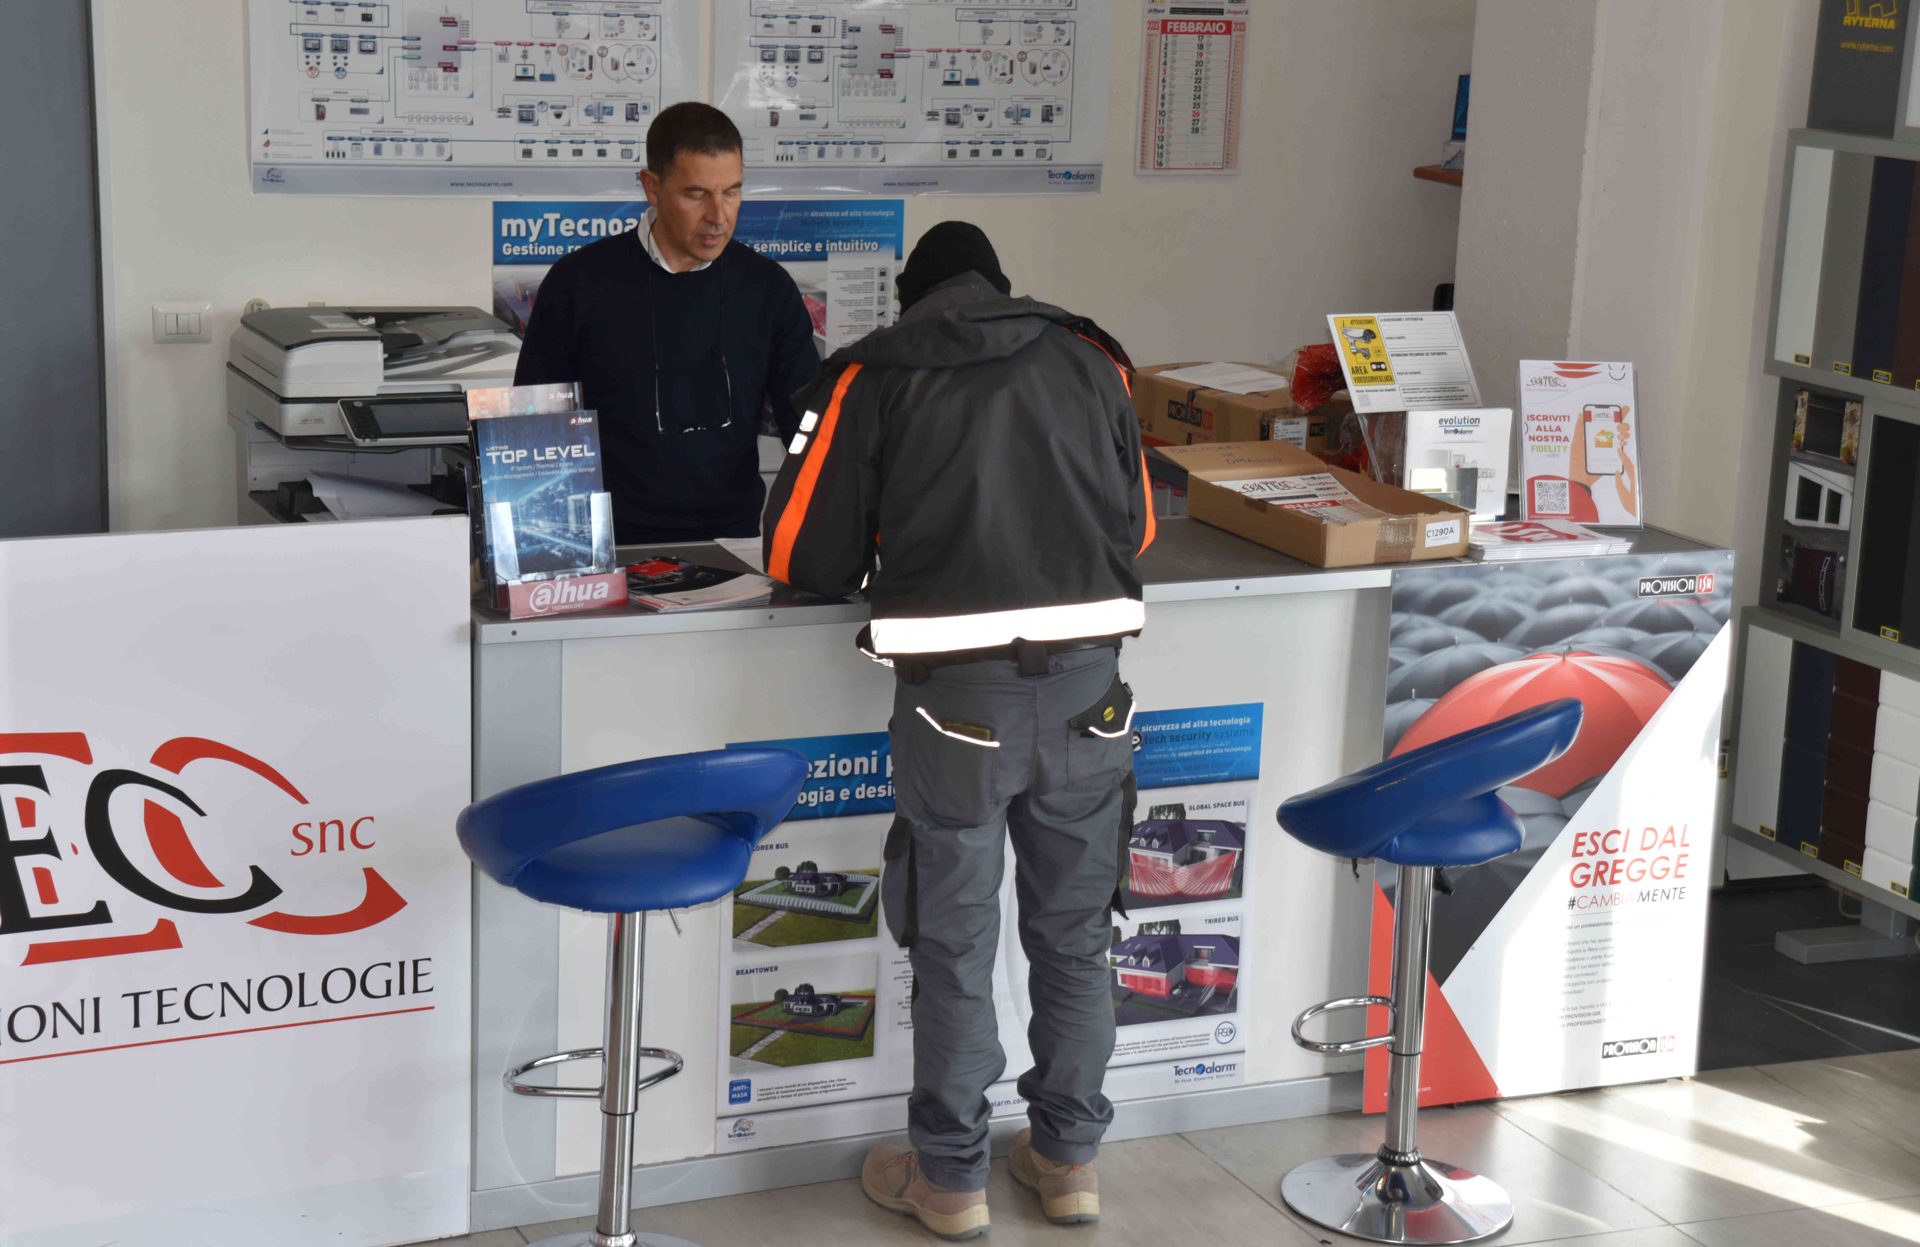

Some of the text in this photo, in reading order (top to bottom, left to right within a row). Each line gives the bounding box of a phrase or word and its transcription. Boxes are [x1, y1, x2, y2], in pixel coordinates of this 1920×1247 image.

[1167, 22, 1226, 33] FEBBRAIO
[1843, 15, 1896, 30] RYTERNA
[501, 213, 645, 242] myTecnoa
[502, 243, 564, 256] Gestione
[753, 240, 812, 255] semplice
[815, 243, 823, 252] e
[826, 239, 879, 251] intuitivo
[1351, 366, 1368, 375] AREA
[1438, 416, 1480, 425] evolution
[1526, 414, 1570, 422] ISCRIVITI
[1536, 424, 1562, 432] ALLA
[486, 444, 595, 464] TOP LEVEL
[504, 472, 534, 480] Management
[1426, 526, 1454, 538] C1290A
[1640, 576, 1712, 594] PROVISION ISR
[1142, 722, 1179, 733] sicurezza
[1181, 721, 1191, 730] ad
[1193, 720, 1208, 729] alta
[1210, 716, 1251, 727] tecnologia
[1169, 731, 1212, 743] security
[1214, 727, 1255, 739] systems
[797, 786, 835, 807] ogia
[839, 787, 850, 801] e
[1189, 803, 1212, 811] GLOBAL
[1213, 801, 1232, 809] SPACE
[290, 815, 376, 856] snc
[1571, 824, 1690, 858] ESCI DAL
[752, 842, 789, 852] LORER BUS
[1569, 854, 1689, 888] GREGGE
[1568, 886, 1686, 910] #CAMBIMENTE
[736, 966, 779, 976] BEAMTOWER
[0, 957, 434, 1045] ONI TECNOLOGIE
[1603, 1038, 1656, 1056] PROVISION
